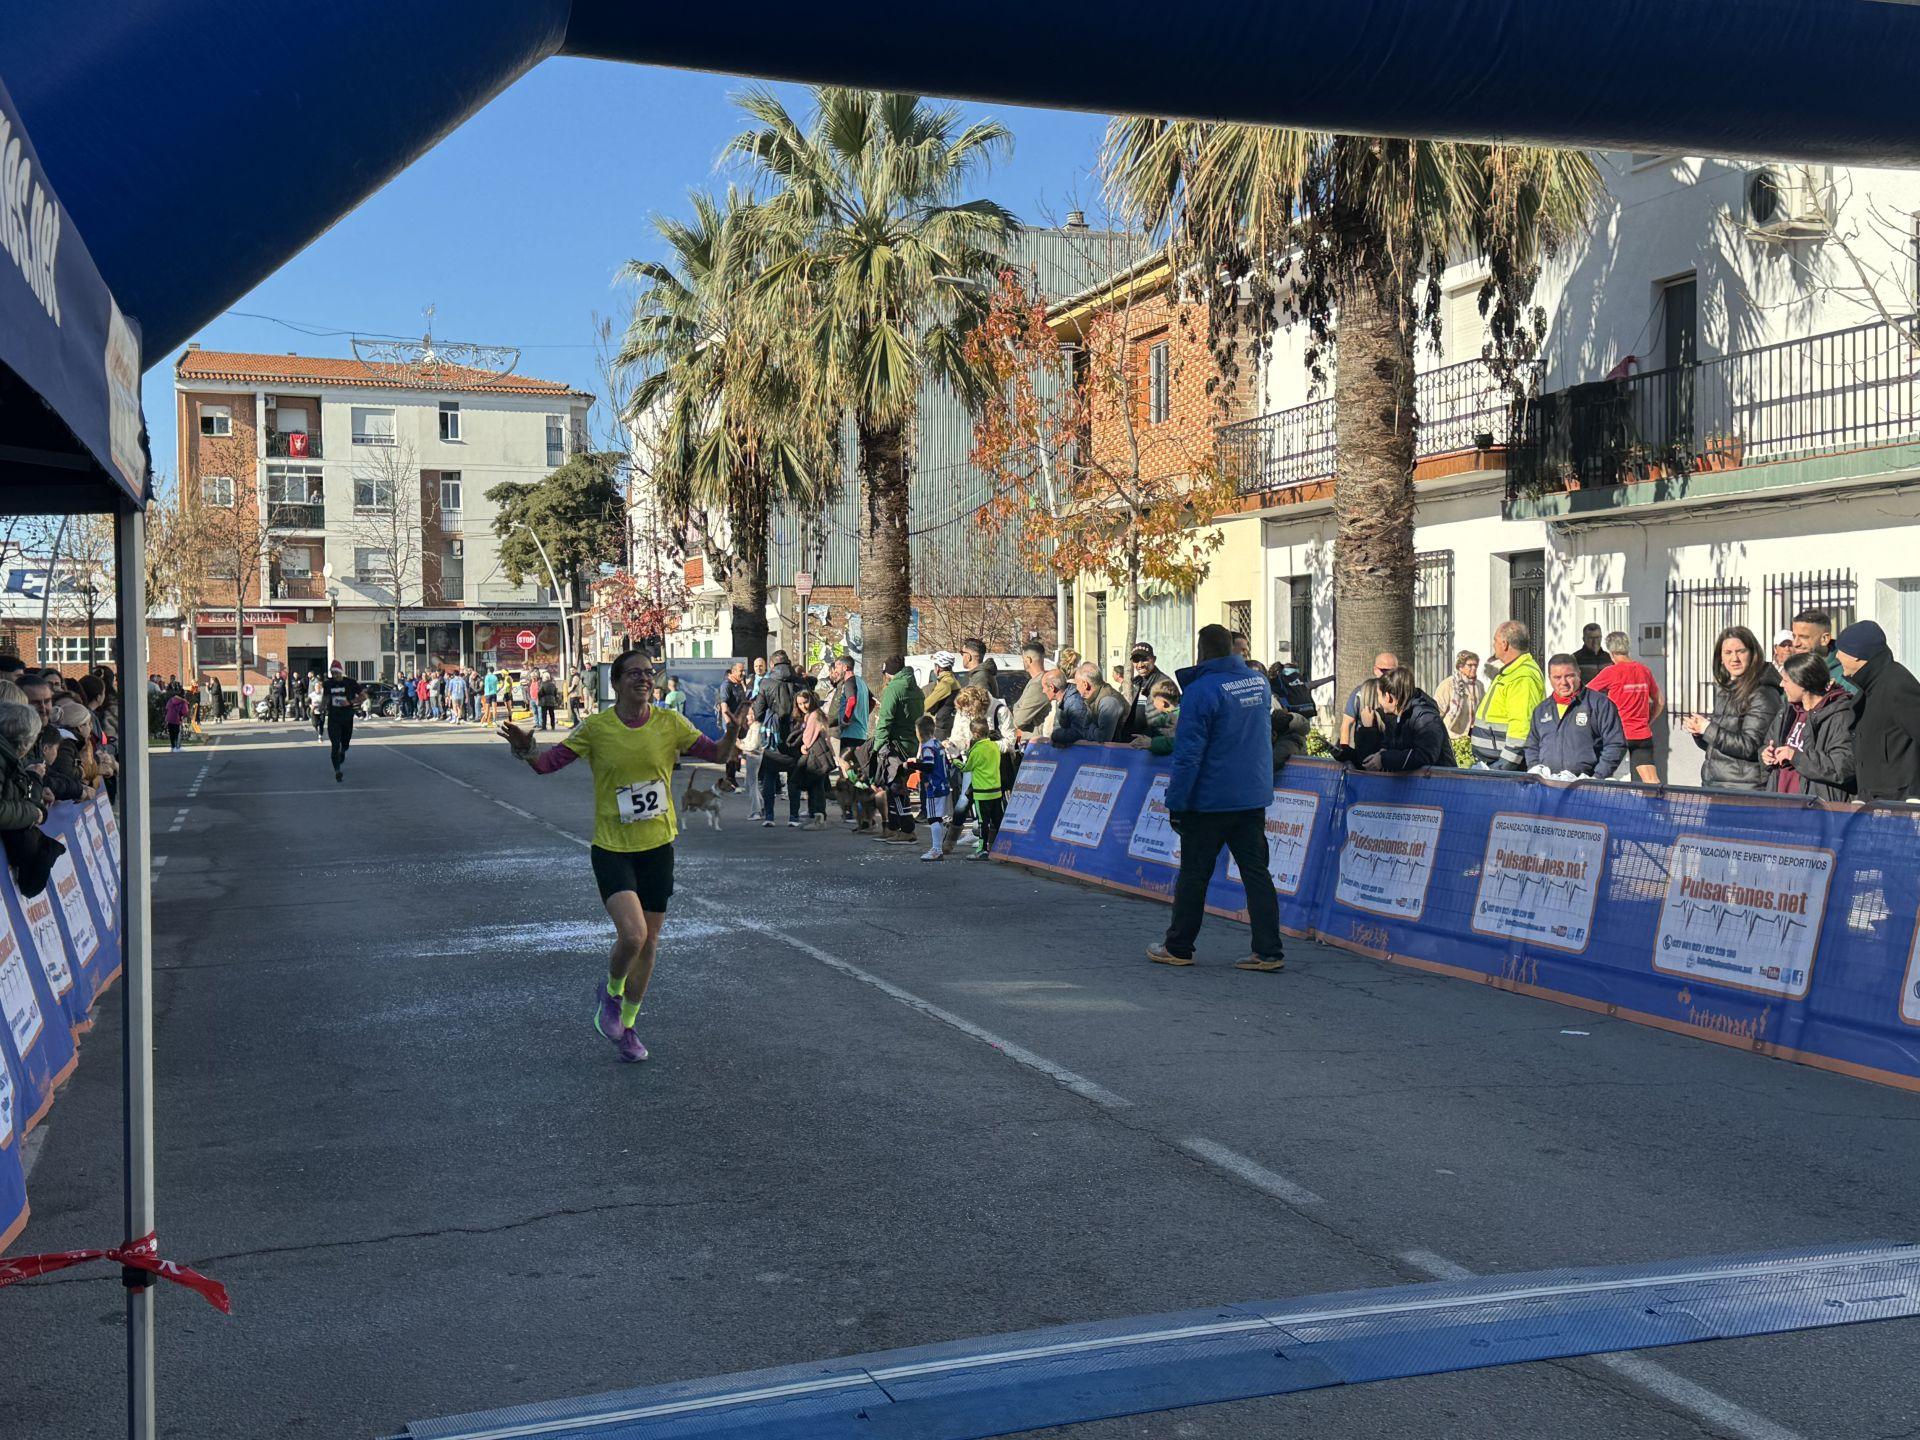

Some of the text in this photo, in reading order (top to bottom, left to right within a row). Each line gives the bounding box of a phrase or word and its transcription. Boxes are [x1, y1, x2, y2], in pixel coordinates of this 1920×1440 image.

[226, 612, 281, 623] GNERALI
[518, 636, 535, 644] STOP
[631, 790, 659, 814] 52
[1265, 816, 1304, 838] iones.net
[1533, 825, 1540, 834] DE
[1540, 826, 1566, 838] EVENTOS
[1566, 828, 1602, 842] DEPORTIVOS
[1495, 848, 1588, 880] Pulsaciones.net
[1679, 844, 1827, 871] ORGANIZACIÓN DE EVENTOS DEPORTIVOS
[1680, 875, 1808, 915] Pulsaciones.net
[0, 1271, 27, 1286] ional
